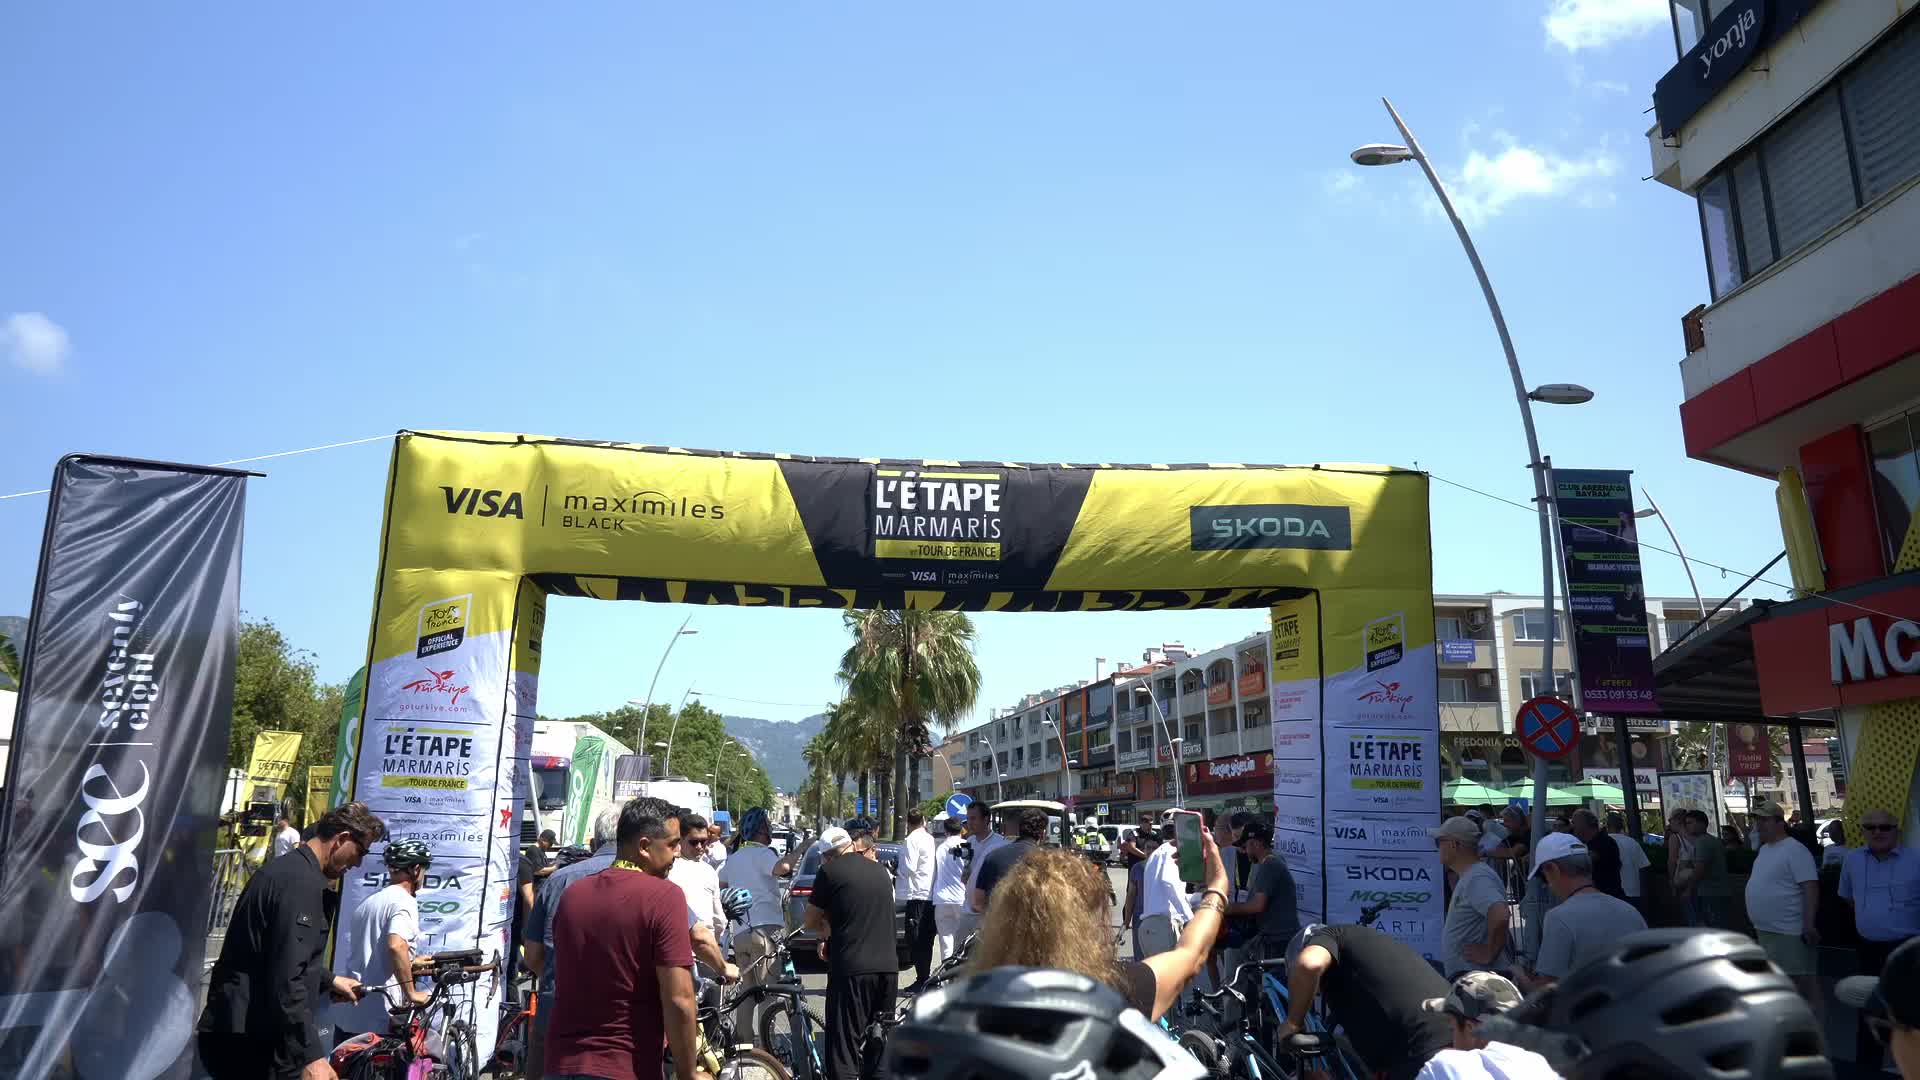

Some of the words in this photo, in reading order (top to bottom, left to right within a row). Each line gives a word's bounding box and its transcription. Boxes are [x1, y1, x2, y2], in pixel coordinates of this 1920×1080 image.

[1699, 8, 1756, 79] yonja
[876, 471, 1000, 512] L'ÉTAPE
[438, 486, 524, 519] VISA
[563, 491, 725, 520] maximiles
[562, 515, 625, 530] BLACK
[917, 545, 944, 557] TOUR
[945, 546, 957, 557] DE
[959, 546, 996, 558] FRANCE
[911, 571, 937, 582] VISA
[948, 571, 1000, 580] maximiles
[427, 633, 454, 645] OFFICIAL
[421, 639, 459, 654] EXPERIENCE
[402, 676, 470, 705] Türkiye
[1627, 690, 1638, 699] 93
[1640, 690, 1653, 700] 48
[399, 703, 468, 713] goturkiye.com
[384, 728, 472, 758] L'ÉTAPE
[1350, 735, 1422, 761] L'ÉTAPE
[1504, 738, 1521, 747] CO
[409, 778, 428, 788] TOUR
[428, 779, 438, 788] DE
[438, 779, 465, 789] FRANCE
[408, 829, 484, 842] maximiles
[1334, 827, 1367, 840] VISA
[1381, 826, 1428, 838] maximil
[362, 872, 462, 890] SDA
[1349, 890, 1432, 903] MOSSO
[417, 901, 460, 914] SSO
[1375, 920, 1425, 933] ARTI
